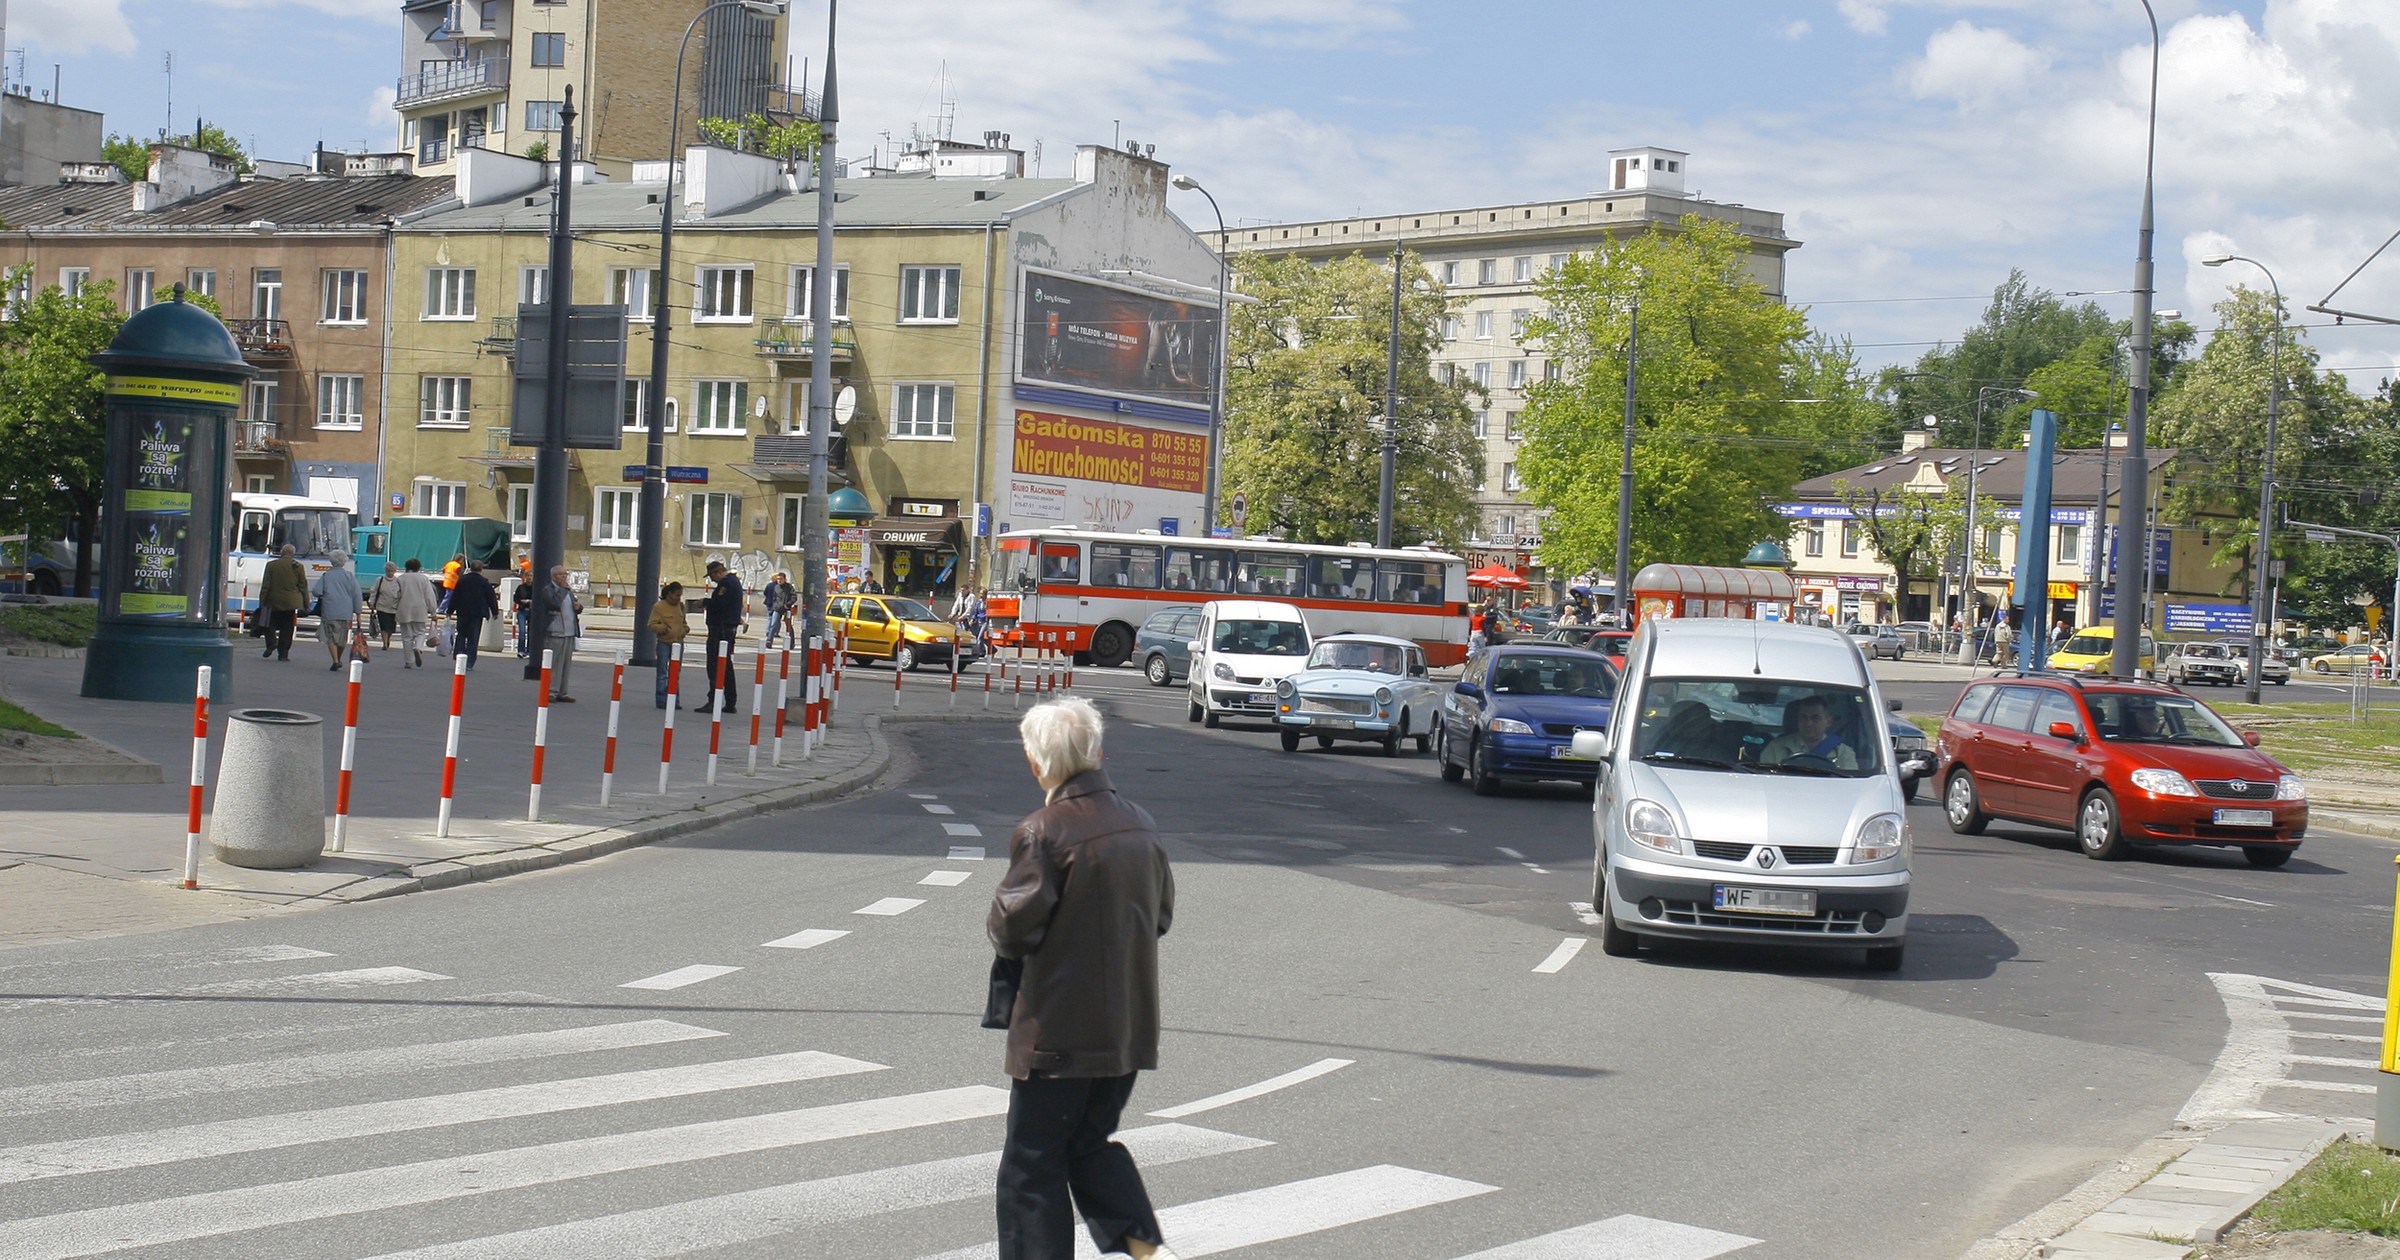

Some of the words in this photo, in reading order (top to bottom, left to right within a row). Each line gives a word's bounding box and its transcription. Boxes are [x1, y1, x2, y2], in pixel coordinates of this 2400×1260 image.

[1043, 293, 1054, 303] Sony
[1054, 296, 1071, 305] Ericsson
[1068, 324, 1078, 334] MÓJ
[1080, 326, 1100, 338] TELEFON
[1105, 331, 1118, 341] MOJA
[1119, 333, 1138, 344] MUZYKA
[161, 385, 202, 394] warexpo
[1018, 413, 1144, 449] Gadomska
[140, 440, 180, 452] Paliwa
[1152, 432, 1171, 450] 870
[1174, 436, 1186, 452] 55
[1189, 438, 1201, 454] 55
[152, 452, 166, 463] są
[1014, 438, 1144, 486] Nieruchomości
[1151, 452, 1170, 465] 0-601
[1172, 454, 1186, 466] 355
[1187, 455, 1200, 468] 130
[140, 464, 177, 475] różne!
[1151, 466, 1170, 479] 0-601
[1171, 468, 1185, 480] 355
[1186, 470, 1200, 482] 320
[1012, 483, 1029, 493] BIURO
[1030, 485, 1065, 497] RACHUNKOWE
[393, 496, 401, 505] 85
[883, 532, 927, 542] OBUWIE
[135, 543, 175, 555] Paliwa
[147, 556, 161, 566] są
[135, 567, 172, 578] różne!
[1254, 694, 1262, 702] WE
[1557, 747, 1571, 756] WE
[1727, 889, 1752, 905] WF
